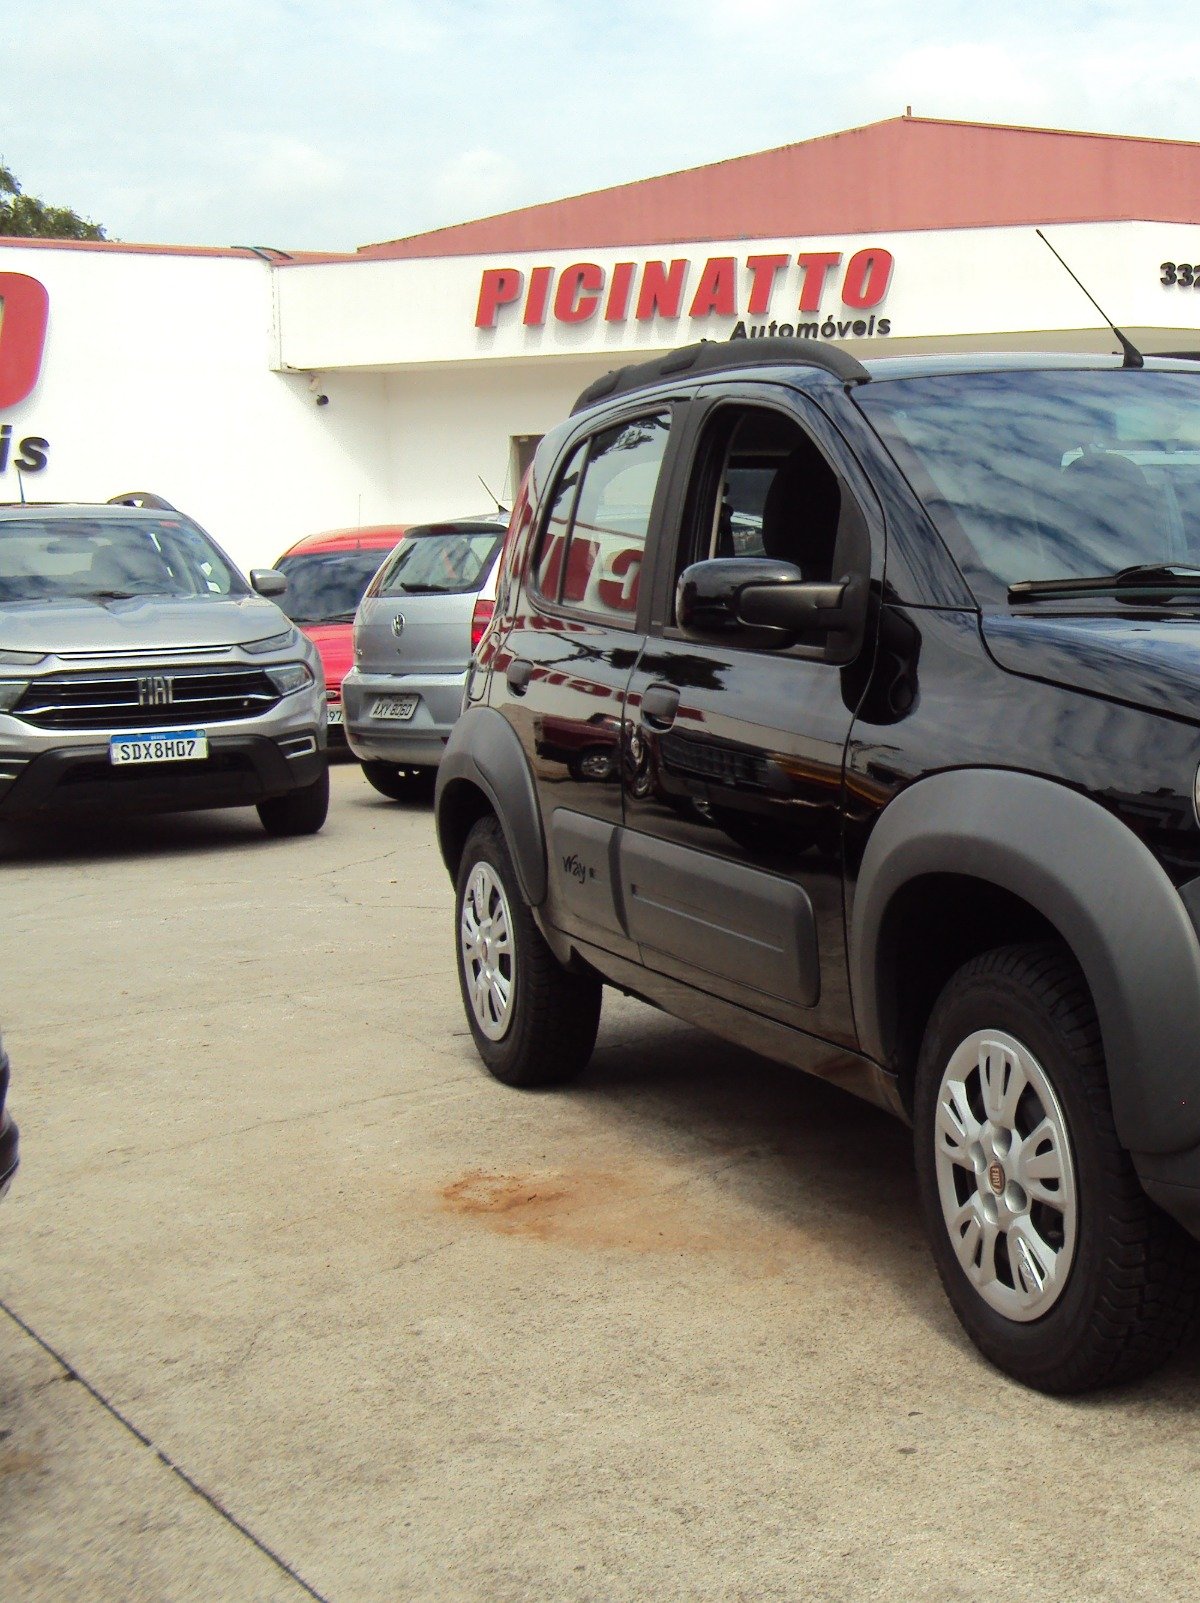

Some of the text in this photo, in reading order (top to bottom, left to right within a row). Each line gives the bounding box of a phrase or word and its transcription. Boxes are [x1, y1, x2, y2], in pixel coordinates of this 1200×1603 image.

[475, 247, 895, 328] PICINATTO
[729, 315, 891, 341] Automóveis
[137, 676, 175, 705] FIAT
[120, 740, 196, 761] SDX8H07
